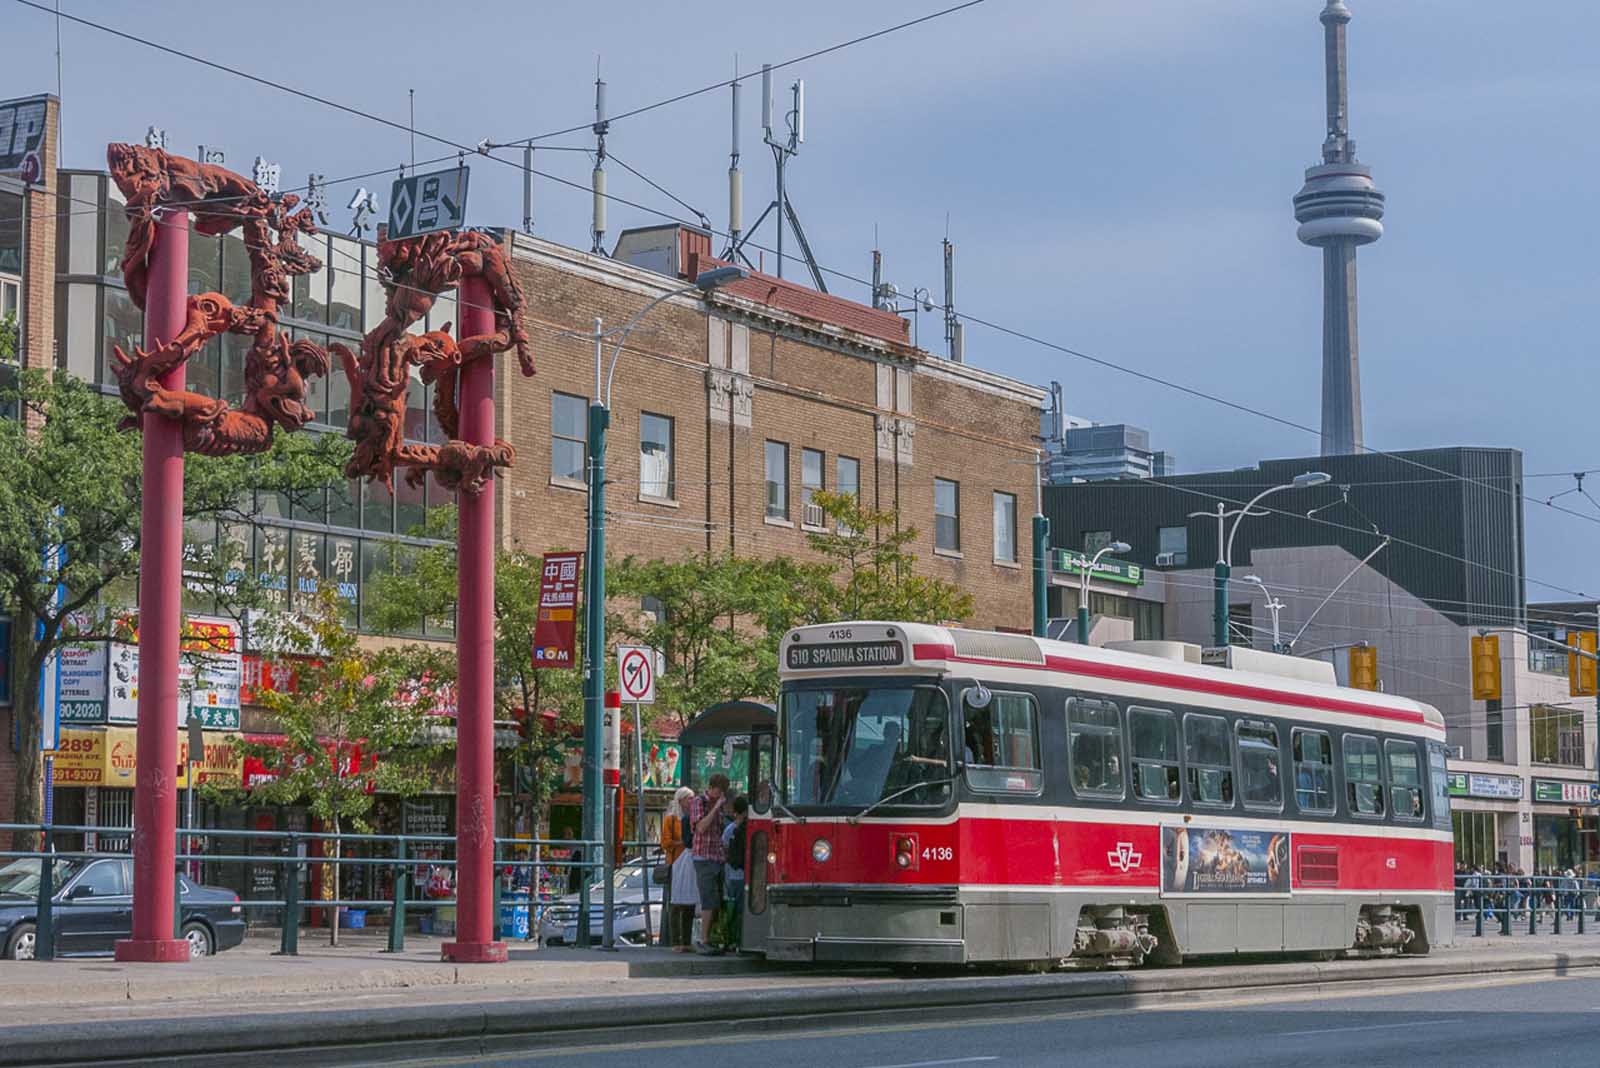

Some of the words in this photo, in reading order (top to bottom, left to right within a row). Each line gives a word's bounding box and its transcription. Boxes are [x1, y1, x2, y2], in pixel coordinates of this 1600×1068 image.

[544, 562, 576, 582] 中國
[828, 629, 852, 640] 4136
[536, 650, 569, 661] ROM
[791, 649, 809, 665] 510
[812, 647, 855, 664] SPADINA
[856, 645, 897, 662] STATION
[922, 847, 953, 861] 4136
